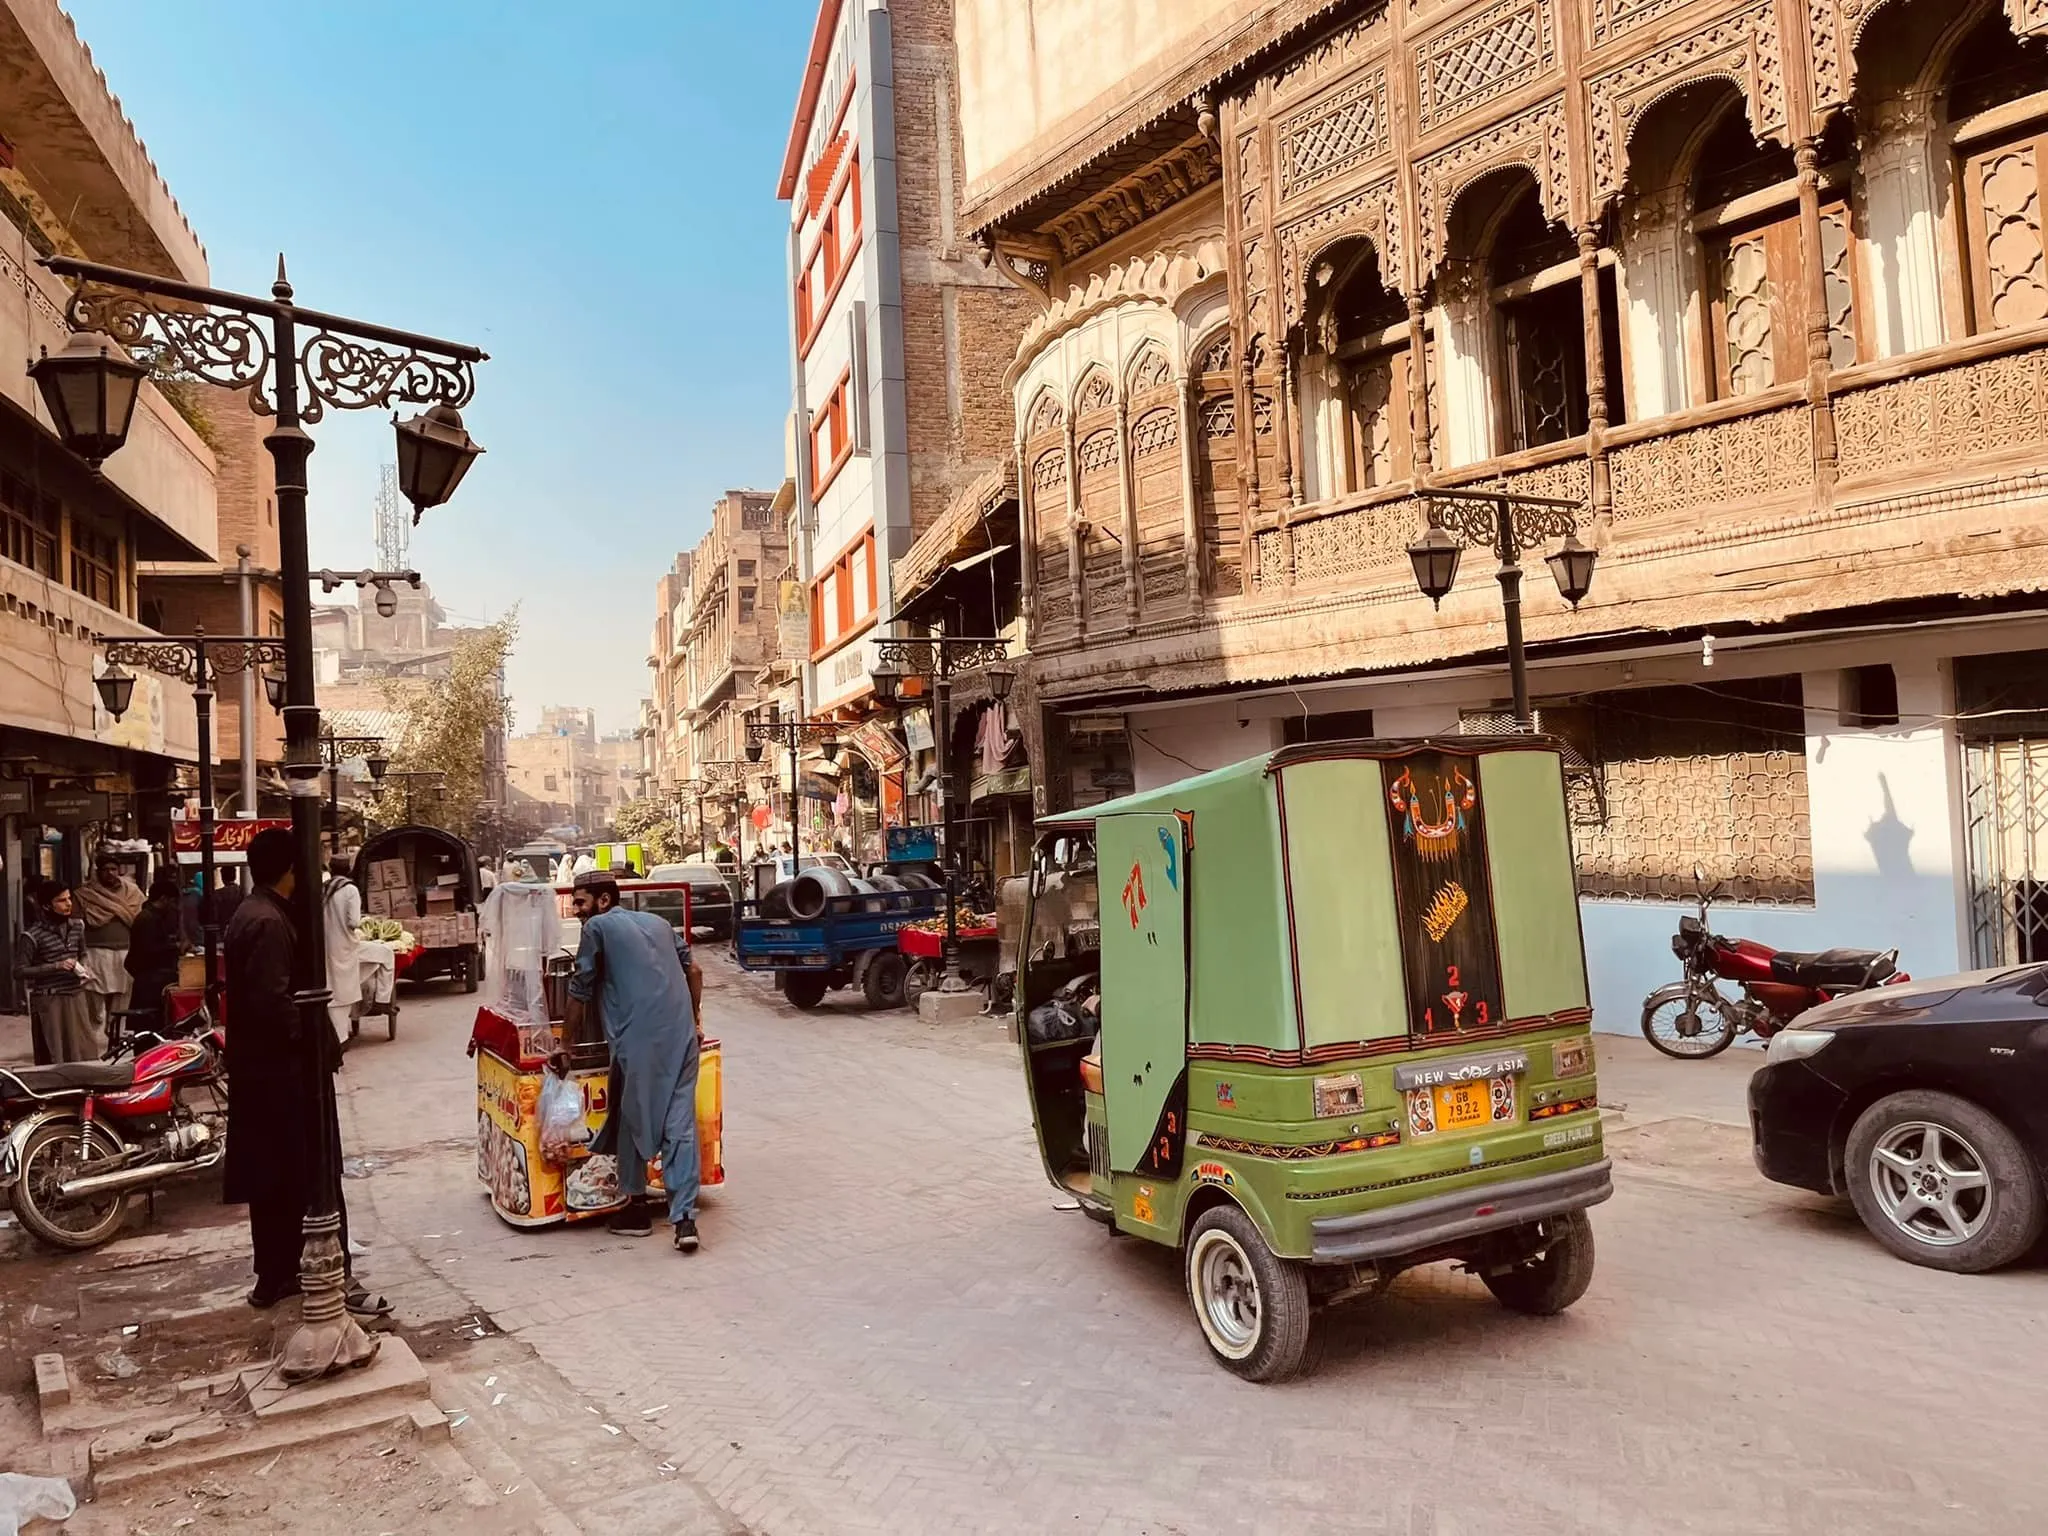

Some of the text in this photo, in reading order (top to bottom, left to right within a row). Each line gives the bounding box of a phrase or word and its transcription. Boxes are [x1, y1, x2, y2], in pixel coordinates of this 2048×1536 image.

[1446, 965, 1460, 986] 2
[1424, 1001, 1489, 1032] 1 3
[1414, 1059, 1524, 1085] NEW ASIA
